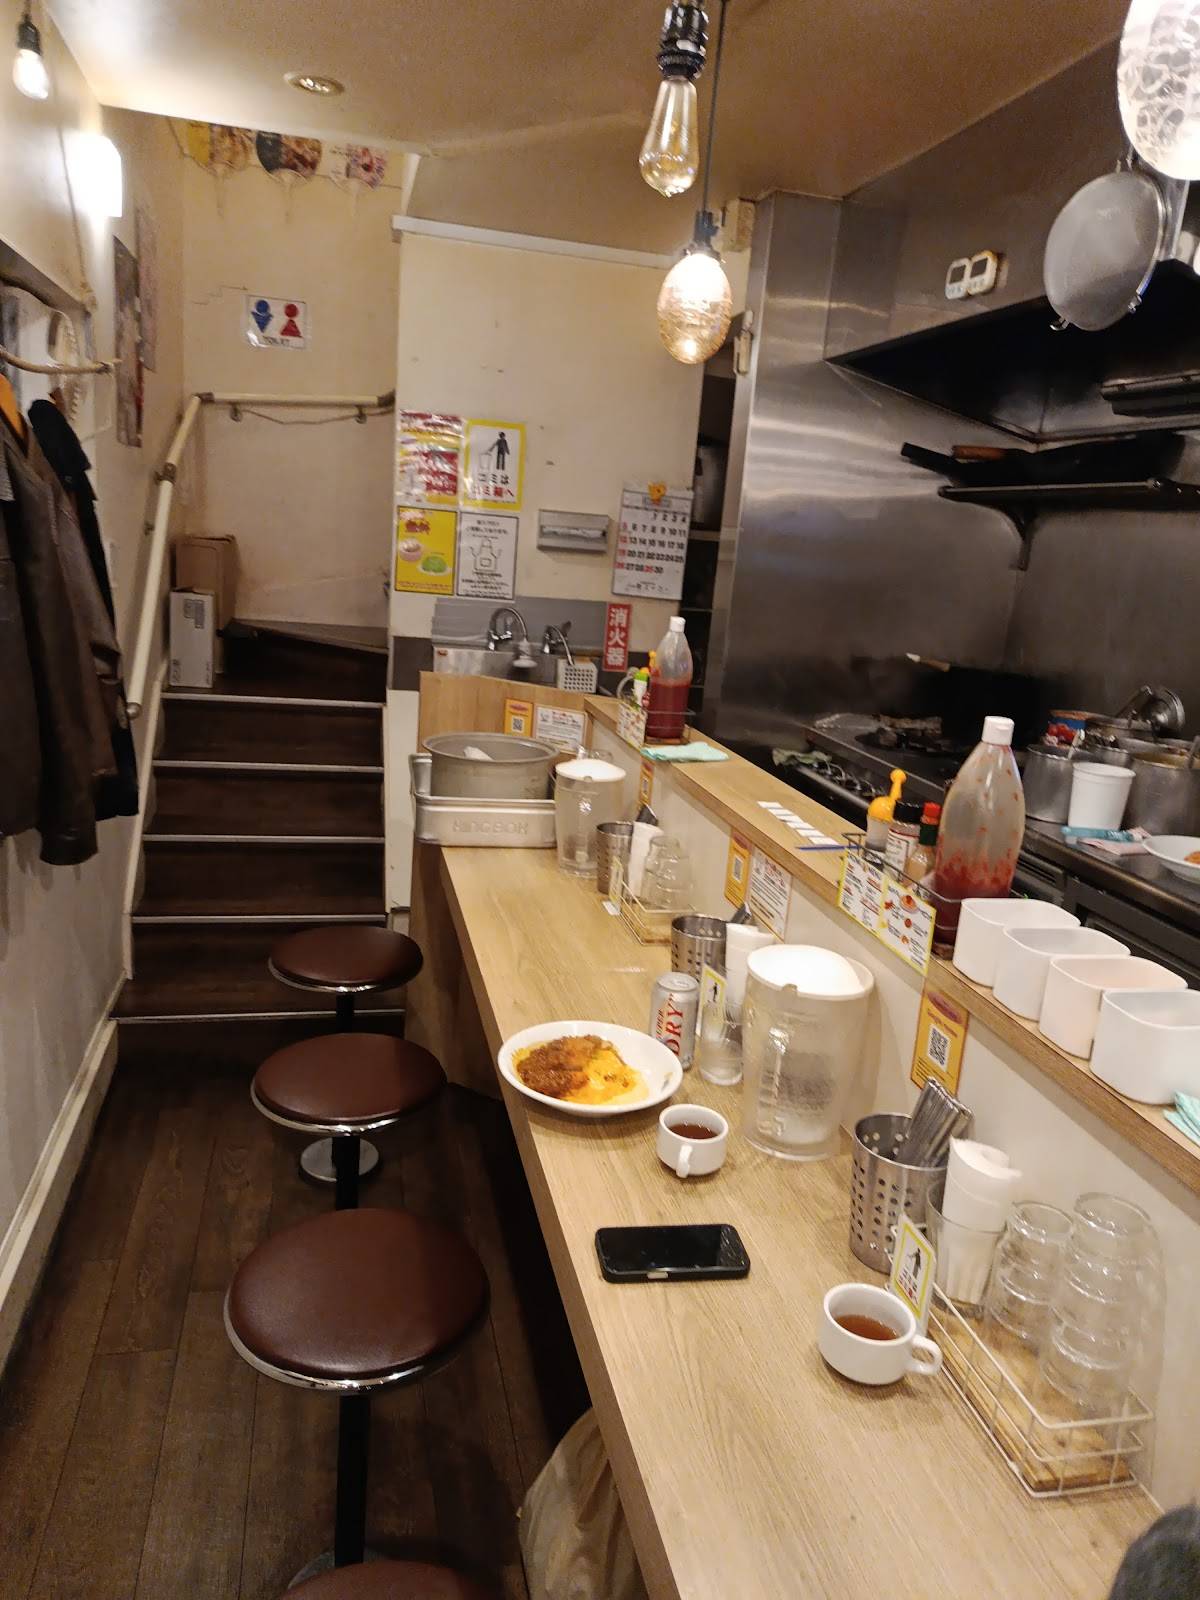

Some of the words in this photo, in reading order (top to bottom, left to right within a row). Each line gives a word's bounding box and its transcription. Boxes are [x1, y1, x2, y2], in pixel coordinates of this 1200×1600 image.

[642, 524, 647, 532] 7
[669, 528, 677, 536] 10
[678, 529, 687, 537] 11
[607, 607, 629, 666] 消火器
